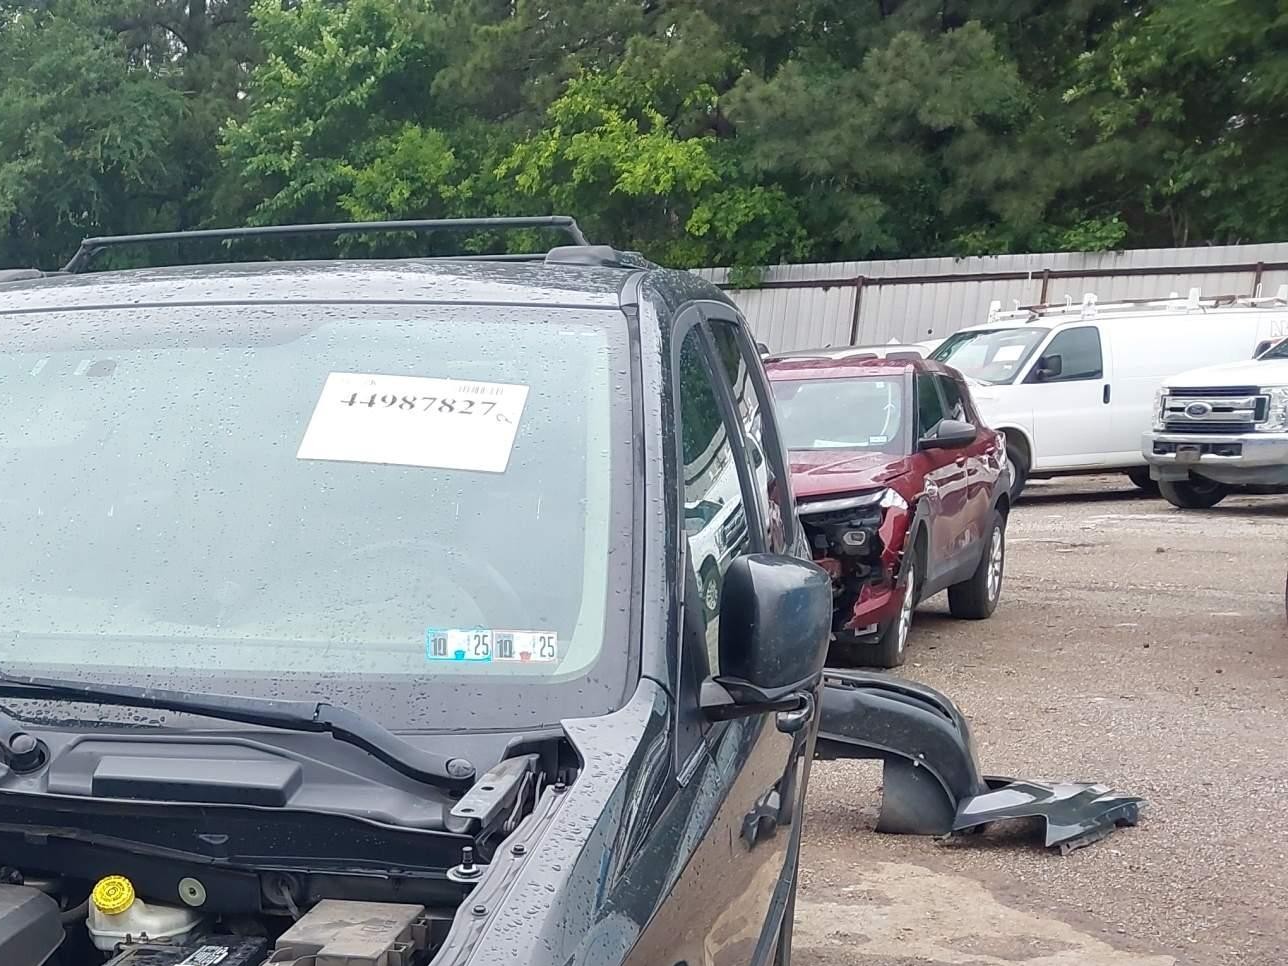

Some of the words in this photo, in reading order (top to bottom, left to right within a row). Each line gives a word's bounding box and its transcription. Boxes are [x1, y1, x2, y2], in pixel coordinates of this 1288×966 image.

[340, 391, 497, 416] 44987827
[431, 637, 448, 656] 10
[474, 634, 489, 656] 25
[496, 639, 513, 658] 10
[539, 635, 555, 658] 25
